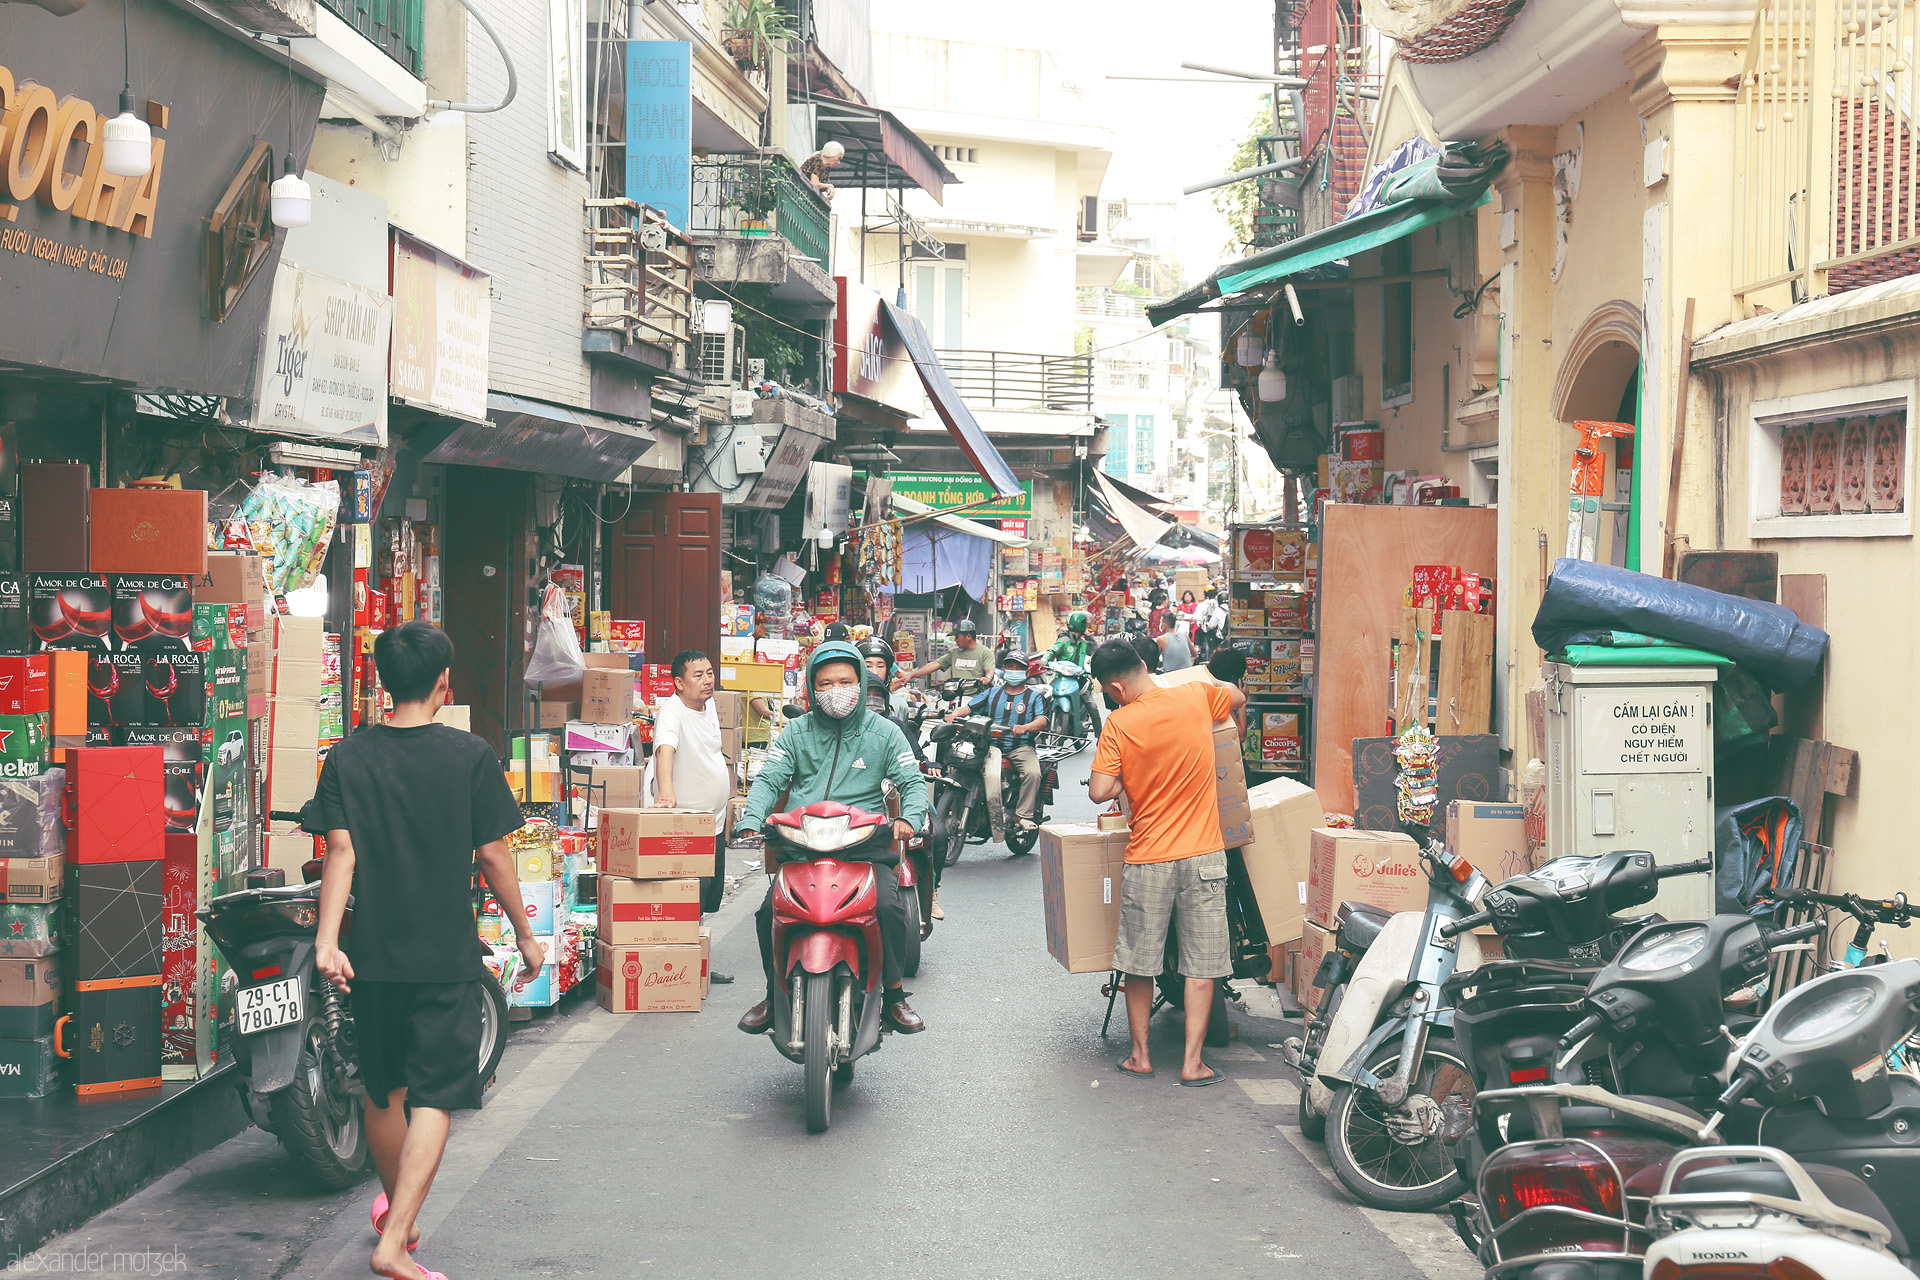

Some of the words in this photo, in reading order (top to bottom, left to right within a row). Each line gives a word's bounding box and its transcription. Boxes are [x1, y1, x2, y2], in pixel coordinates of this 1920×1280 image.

[633, 58, 684, 87] MOTEL
[630, 104, 685, 139] THANH
[0, 228, 31, 258] RƯỢU
[31, 237, 62, 266] NGOẠI
[62, 244, 88, 272] NHẬP
[88, 248, 108, 274] CÁC
[107, 258, 128, 282] LOẠI
[324, 296, 346, 337] SHOP
[276, 332, 308, 400] Tiger
[398, 360, 425, 392] SAIGON
[274, 402, 296, 420] CRYSTAL
[938, 486, 964, 504] TỔNG
[34, 576, 63, 588] AMOR
[80, 578, 107, 589] CHILE
[117, 577, 145, 588] AMOR
[162, 579, 188, 590] CHILE
[98, 655, 110, 663] LA
[114, 655, 141, 663] ROCA
[157, 655, 168, 663] LA
[172, 655, 199, 663] ROCA
[1614, 701, 1638, 718] CẤM
[1642, 706, 1660, 720] LẠI
[1663, 700, 1687, 718] GẦN
[128, 730, 156, 741] AMOR
[173, 732, 199, 742] CHILE
[1632, 723, 1648, 734] CÓ
[1650, 722, 1676, 736] ĐIỆN
[1624, 739, 1654, 748] NGUY
[1658, 734, 1684, 748] HIỂM
[1621, 751, 1650, 762] CHẾT
[1654, 751, 1687, 762] NGƯỜI
[172, 766, 191, 775] CHILE
[611, 832, 632, 850] Daniel
[1377, 864, 1417, 876] Julie's
[644, 966, 688, 987] Daniel
[245, 981, 289, 1009] 29-C1
[242, 1001, 298, 1034] 780.78
[1542, 1244, 1584, 1254] HONDA
